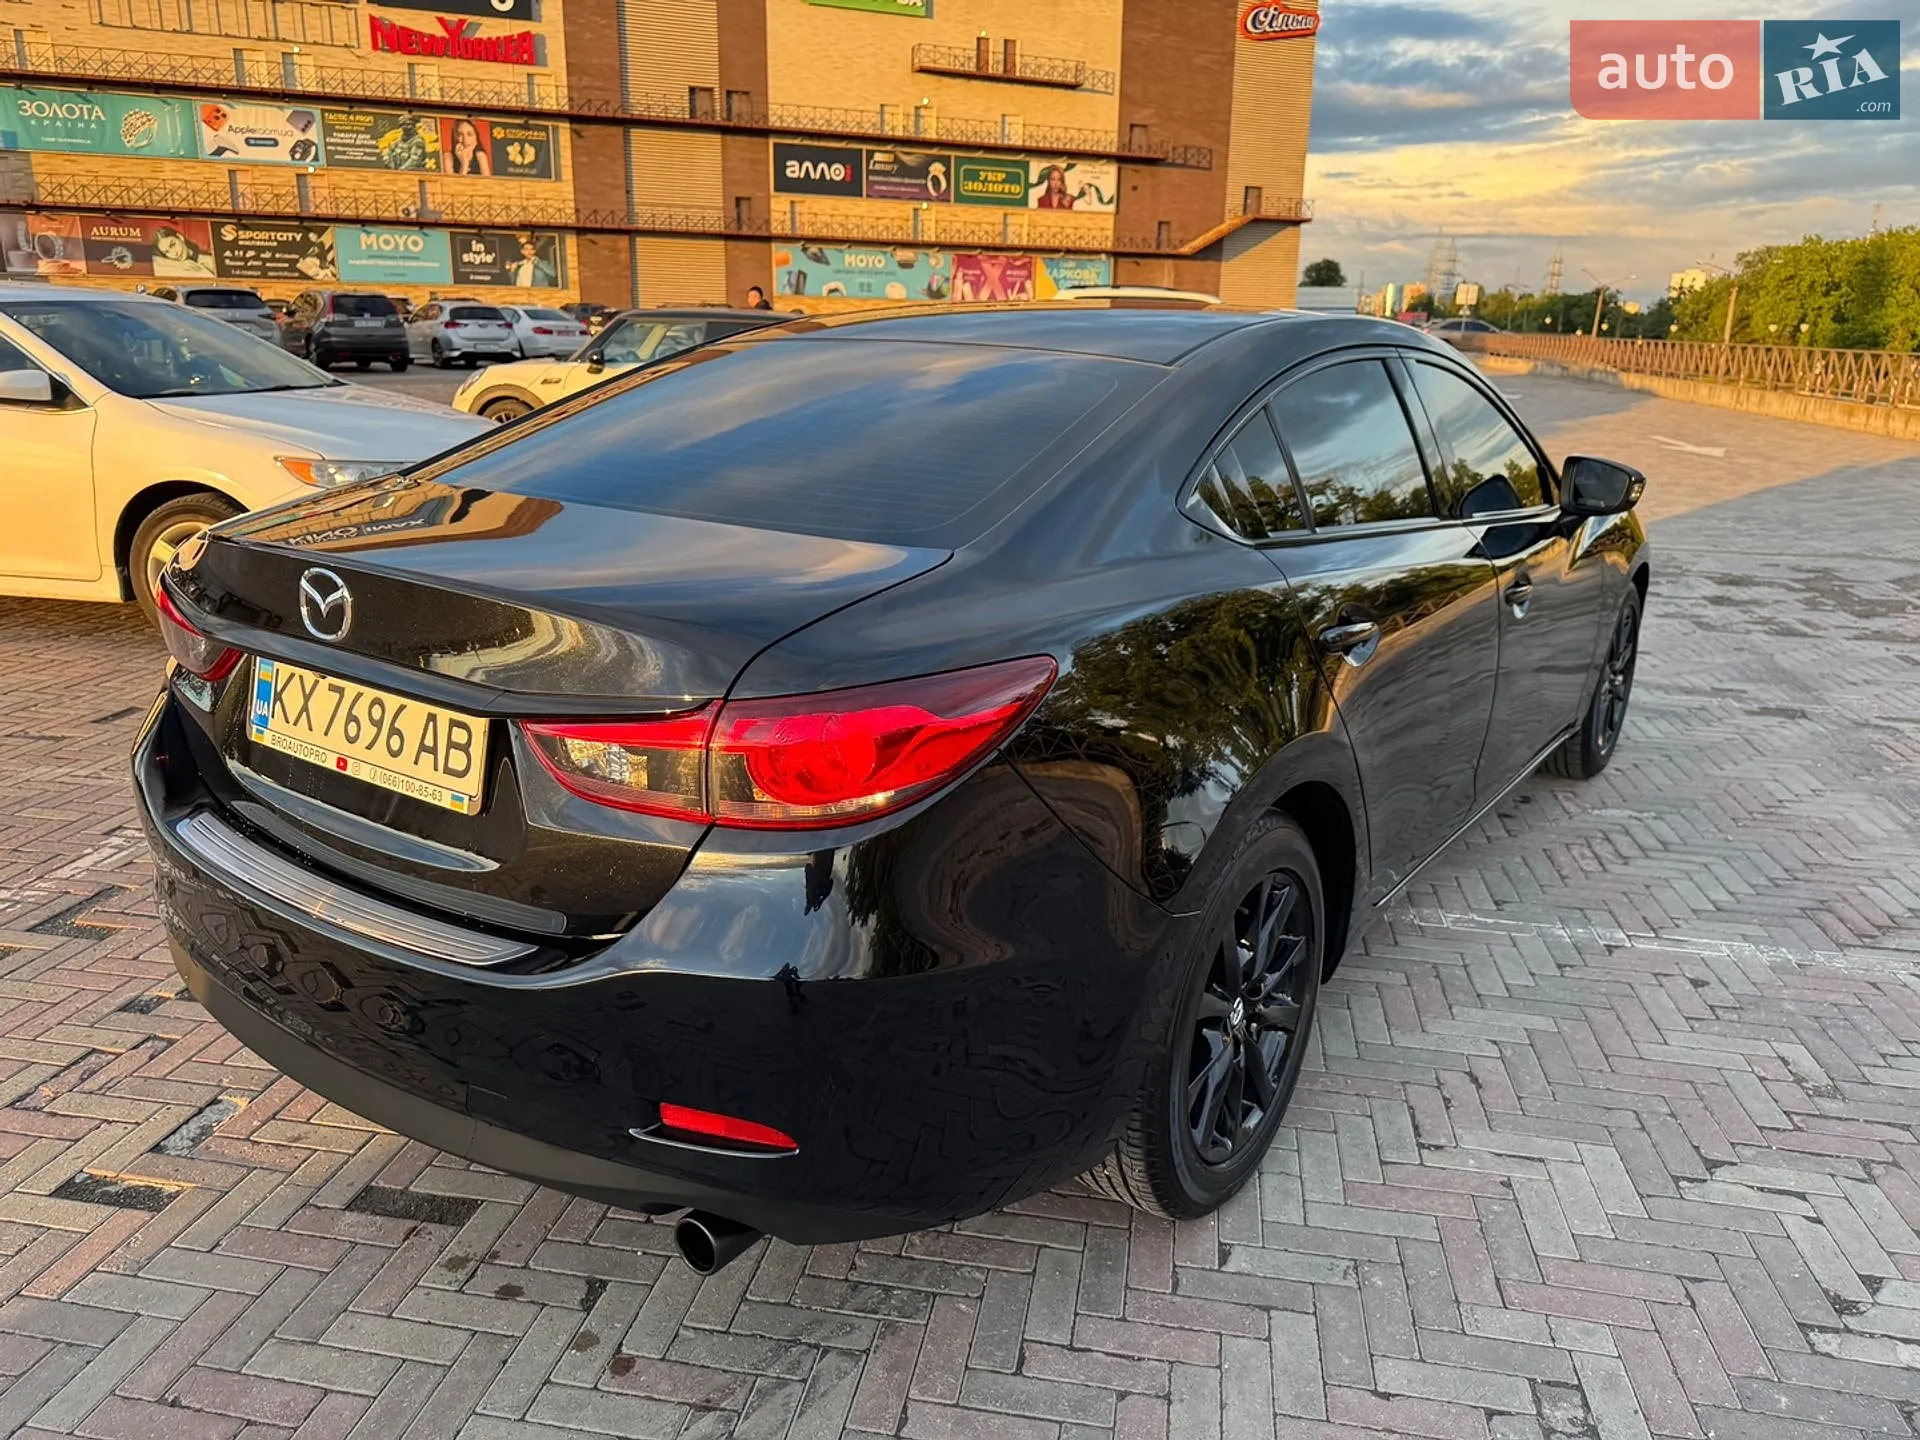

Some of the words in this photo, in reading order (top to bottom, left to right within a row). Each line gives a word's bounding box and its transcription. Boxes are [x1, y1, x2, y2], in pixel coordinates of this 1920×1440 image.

[17, 99, 106, 121] ЗОЛОТА
[91, 226, 141, 237] AURUM
[360, 232, 424, 253] MOYO
[844, 253, 886, 269] MOYO
[256, 699, 269, 717] UA
[271, 667, 320, 732] KX
[324, 682, 408, 759] 7696
[413, 711, 473, 779] AB
[271, 735, 328, 765] BROAUTOPRO
[378, 770, 443, 802] (066)100-85-63
